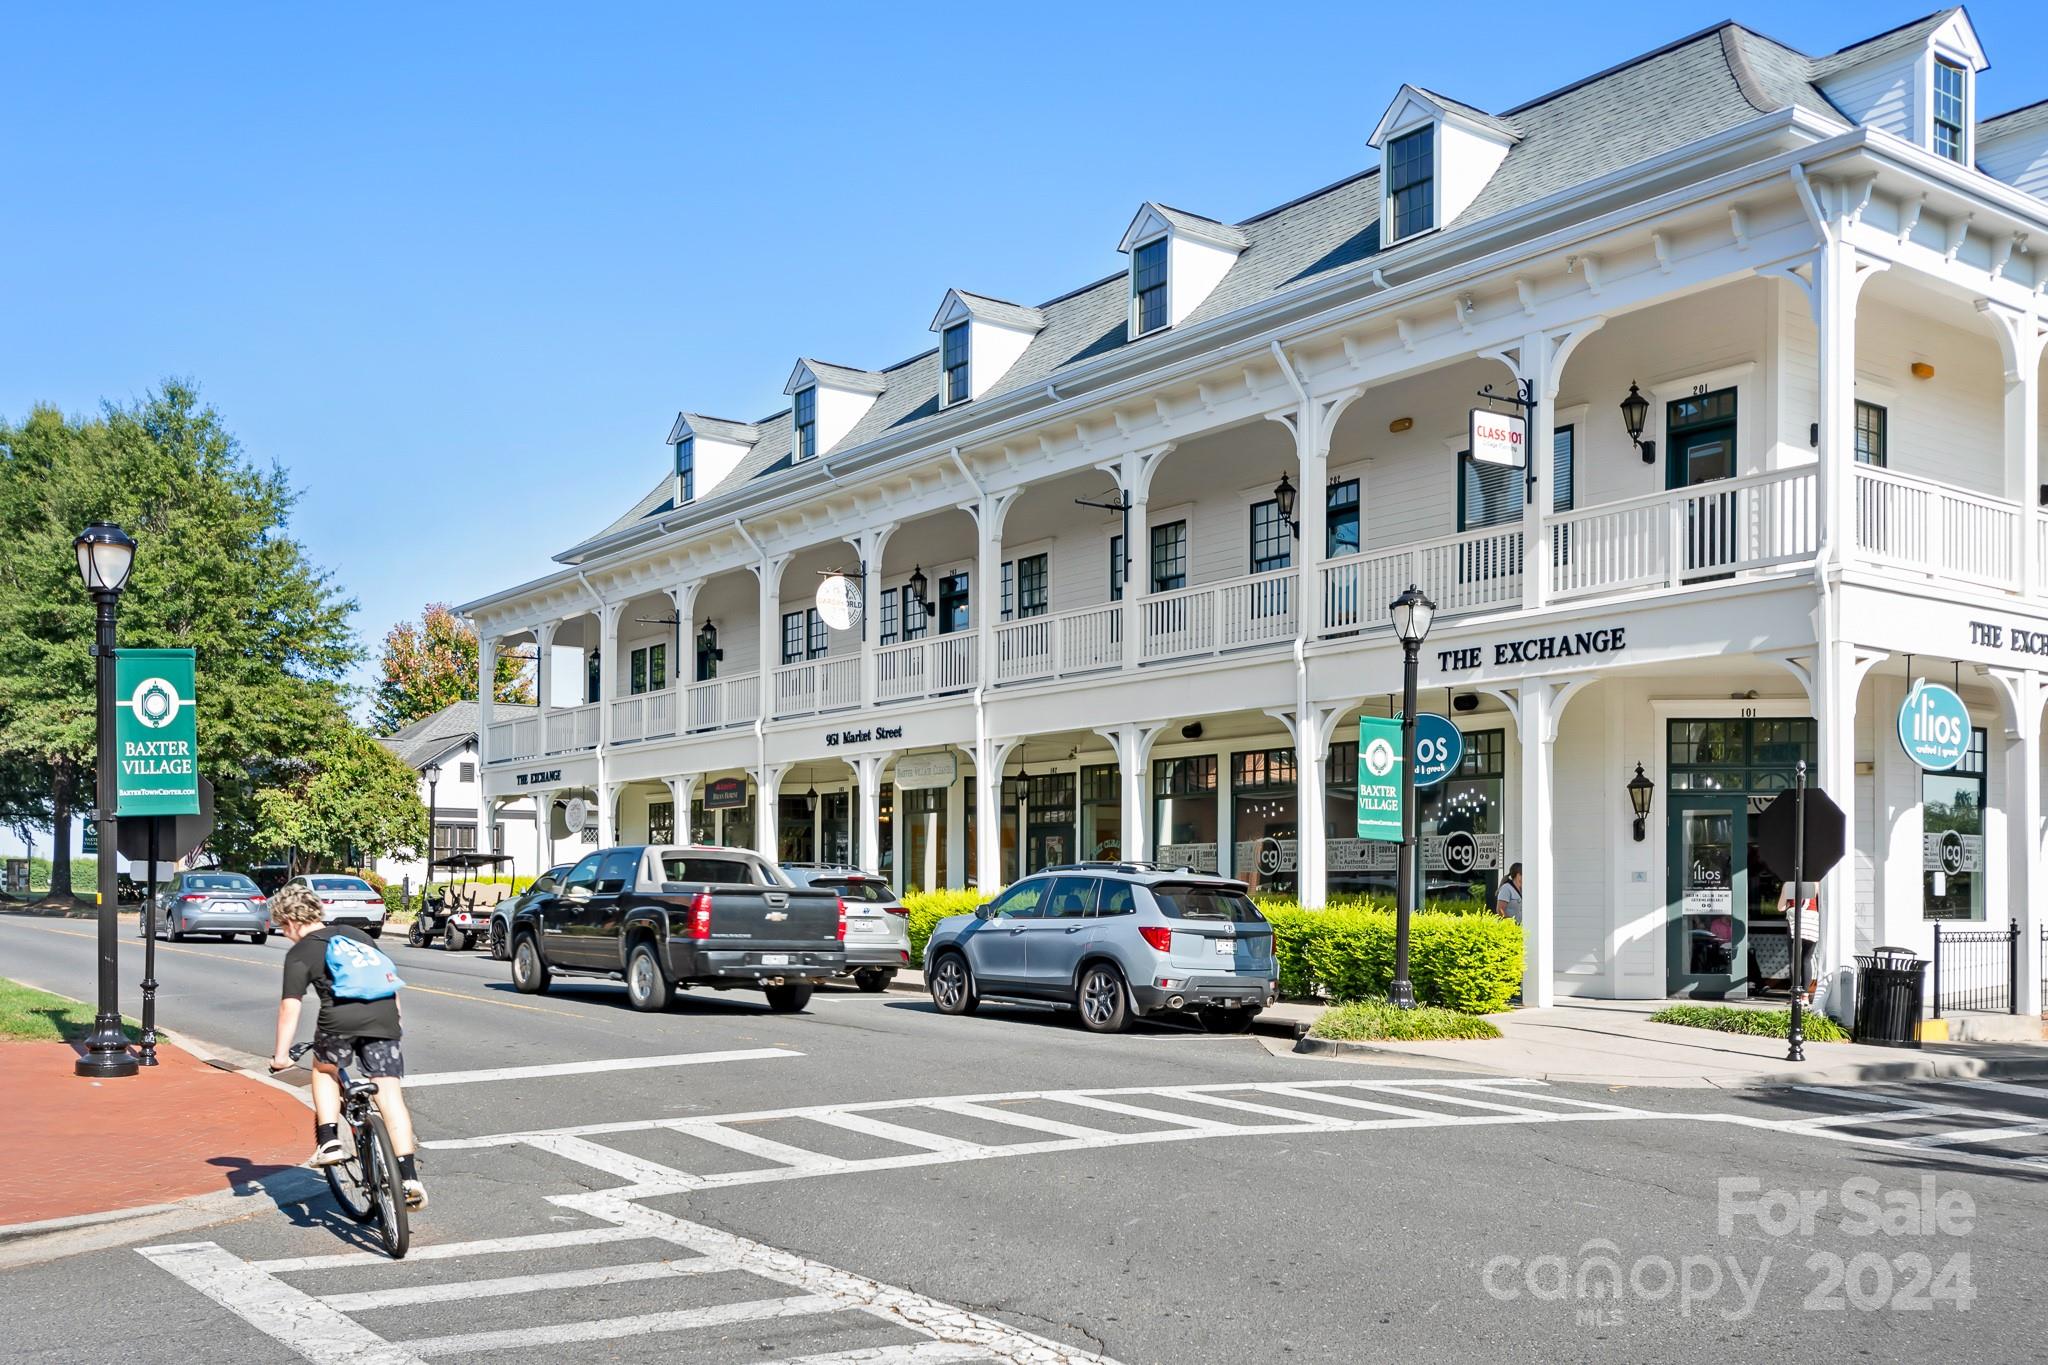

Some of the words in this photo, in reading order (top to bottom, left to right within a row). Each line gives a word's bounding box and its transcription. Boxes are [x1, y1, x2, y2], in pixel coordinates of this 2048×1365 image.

[1693, 384, 1708, 396] 201
[1477, 425, 1506, 441] CLASS
[1508, 431, 1523, 445] 101
[1969, 620, 2004, 649] THE
[1438, 647, 1482, 672] THE
[1494, 627, 1626, 666] EXCHANGE
[1741, 708, 1756, 717] 101
[1912, 690, 1962, 746] ilios
[843, 729, 872, 745] Market
[876, 725, 902, 740] Street
[125, 740, 190, 757] BAXTER
[121, 759, 193, 775] VILLAGE
[516, 774, 528, 786] THE
[530, 769, 561, 784] EXCHANGE
[1360, 784, 1397, 798] BAXTER
[1359, 798, 1399, 811] VILLAGE
[1261, 850, 1278, 869] cg
[1693, 861, 1721, 880] ilios
